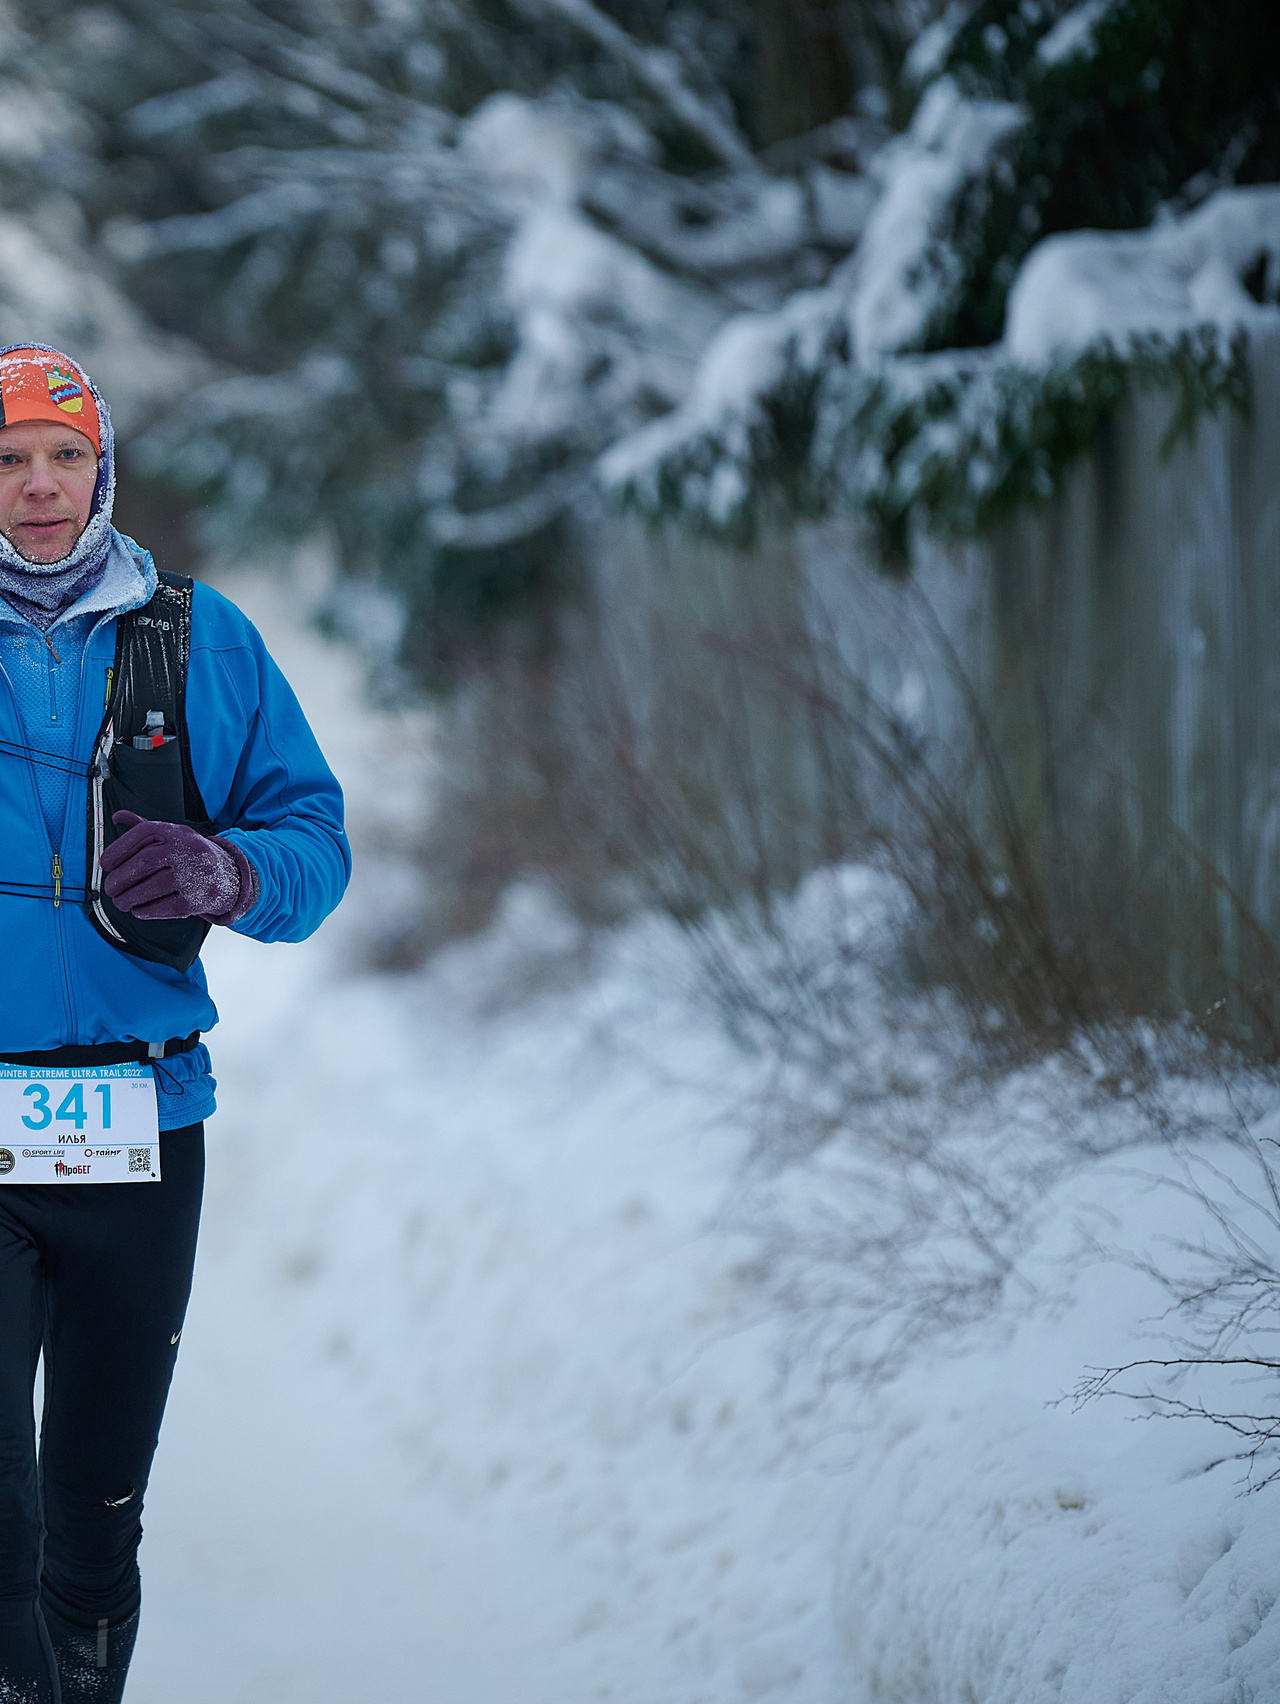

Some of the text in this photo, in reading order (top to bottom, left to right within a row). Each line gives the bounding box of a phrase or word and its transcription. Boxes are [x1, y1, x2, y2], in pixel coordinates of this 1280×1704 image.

[30, 1069, 69, 1078] EXTREME
[71, 1069, 98, 1078] ULTRA
[100, 1069, 121, 1077] TRAIL
[21, 1083, 112, 1131] 341
[58, 1134, 86, 1144] ИЛЬЯ
[63, 1165, 91, 1176] ПроБЕГ
